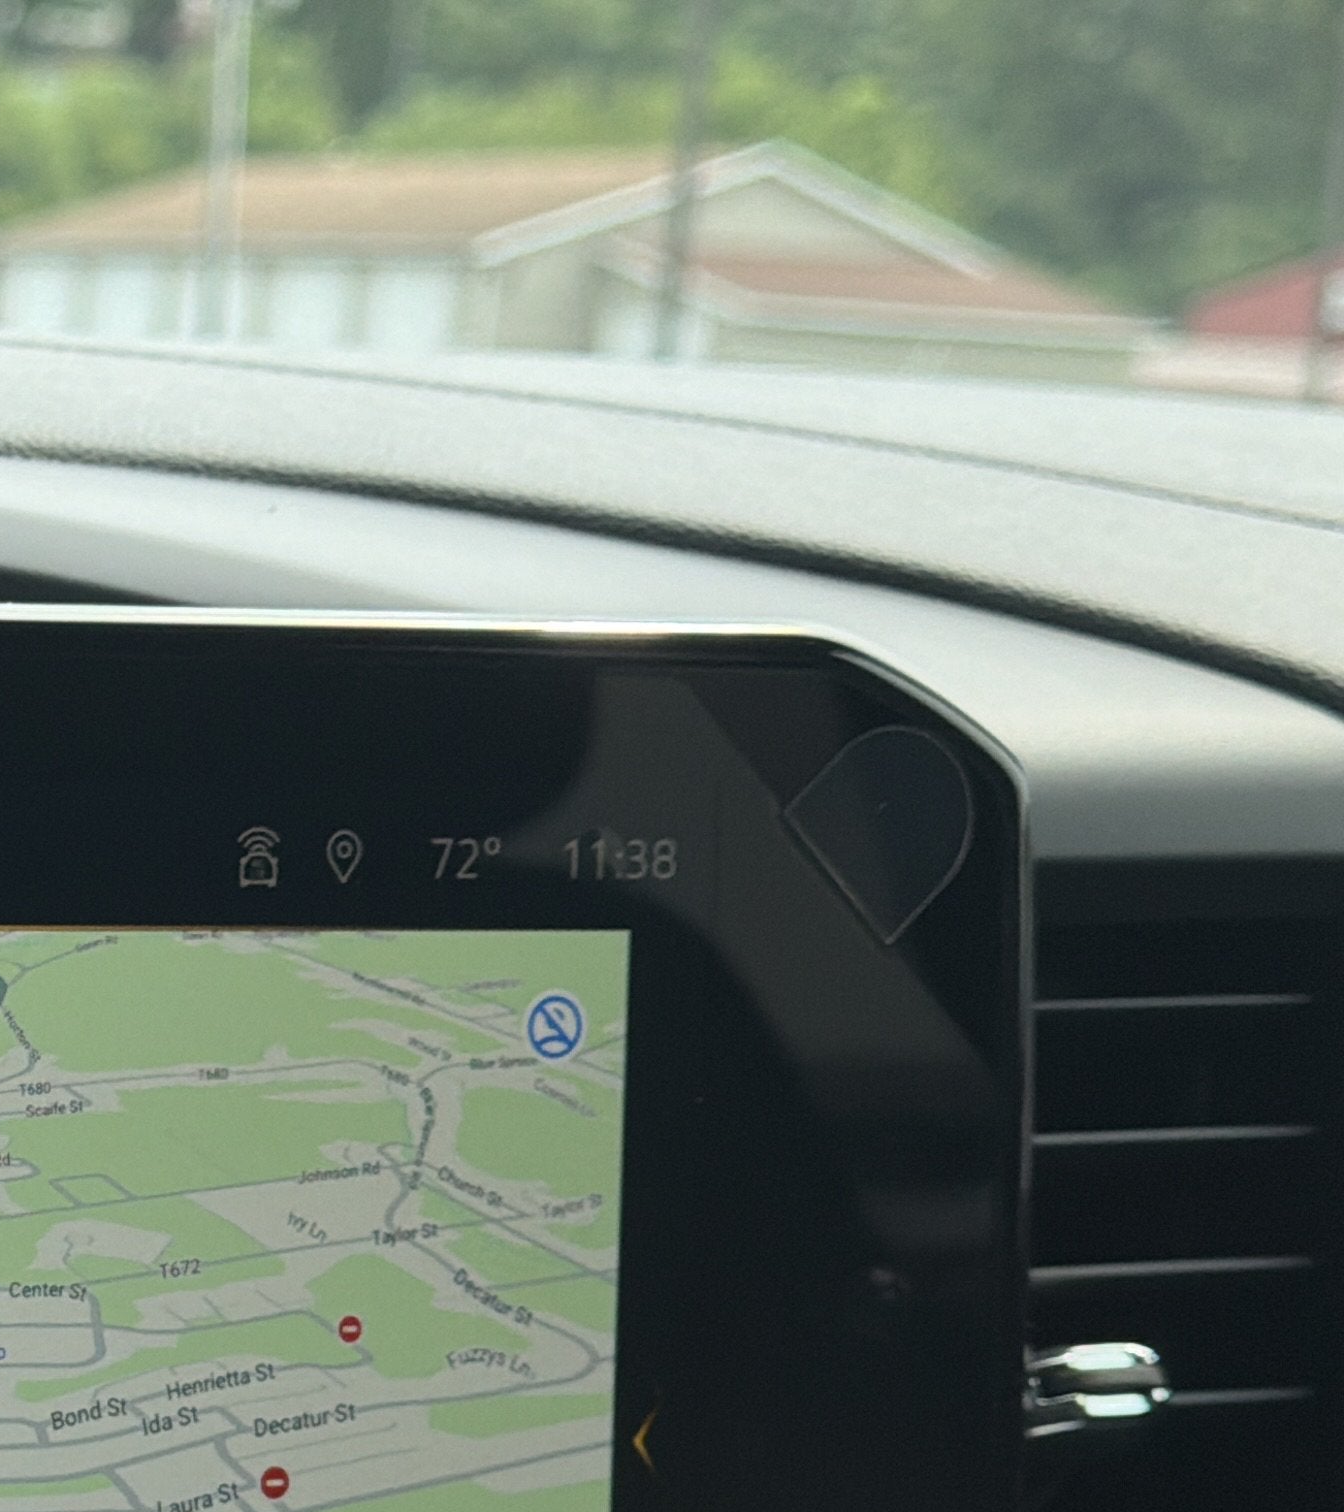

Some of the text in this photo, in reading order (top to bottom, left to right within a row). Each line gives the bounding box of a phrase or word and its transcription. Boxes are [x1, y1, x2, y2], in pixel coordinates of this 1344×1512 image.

[563, 837, 679, 880] 11:38
[69, 1101, 83, 1115] St
[362, 1161, 381, 1175] Rd
[421, 1222, 439, 1239] St
[159, 1258, 201, 1280] T672
[8, 1281, 88, 1302] Center St
[165, 1363, 276, 1400] Henrietta St
[50, 1398, 127, 1431] Bond St
[141, 1406, 199, 1436] Ida St
[253, 1402, 356, 1439] Decatur St
[217, 1482, 240, 1504] St
